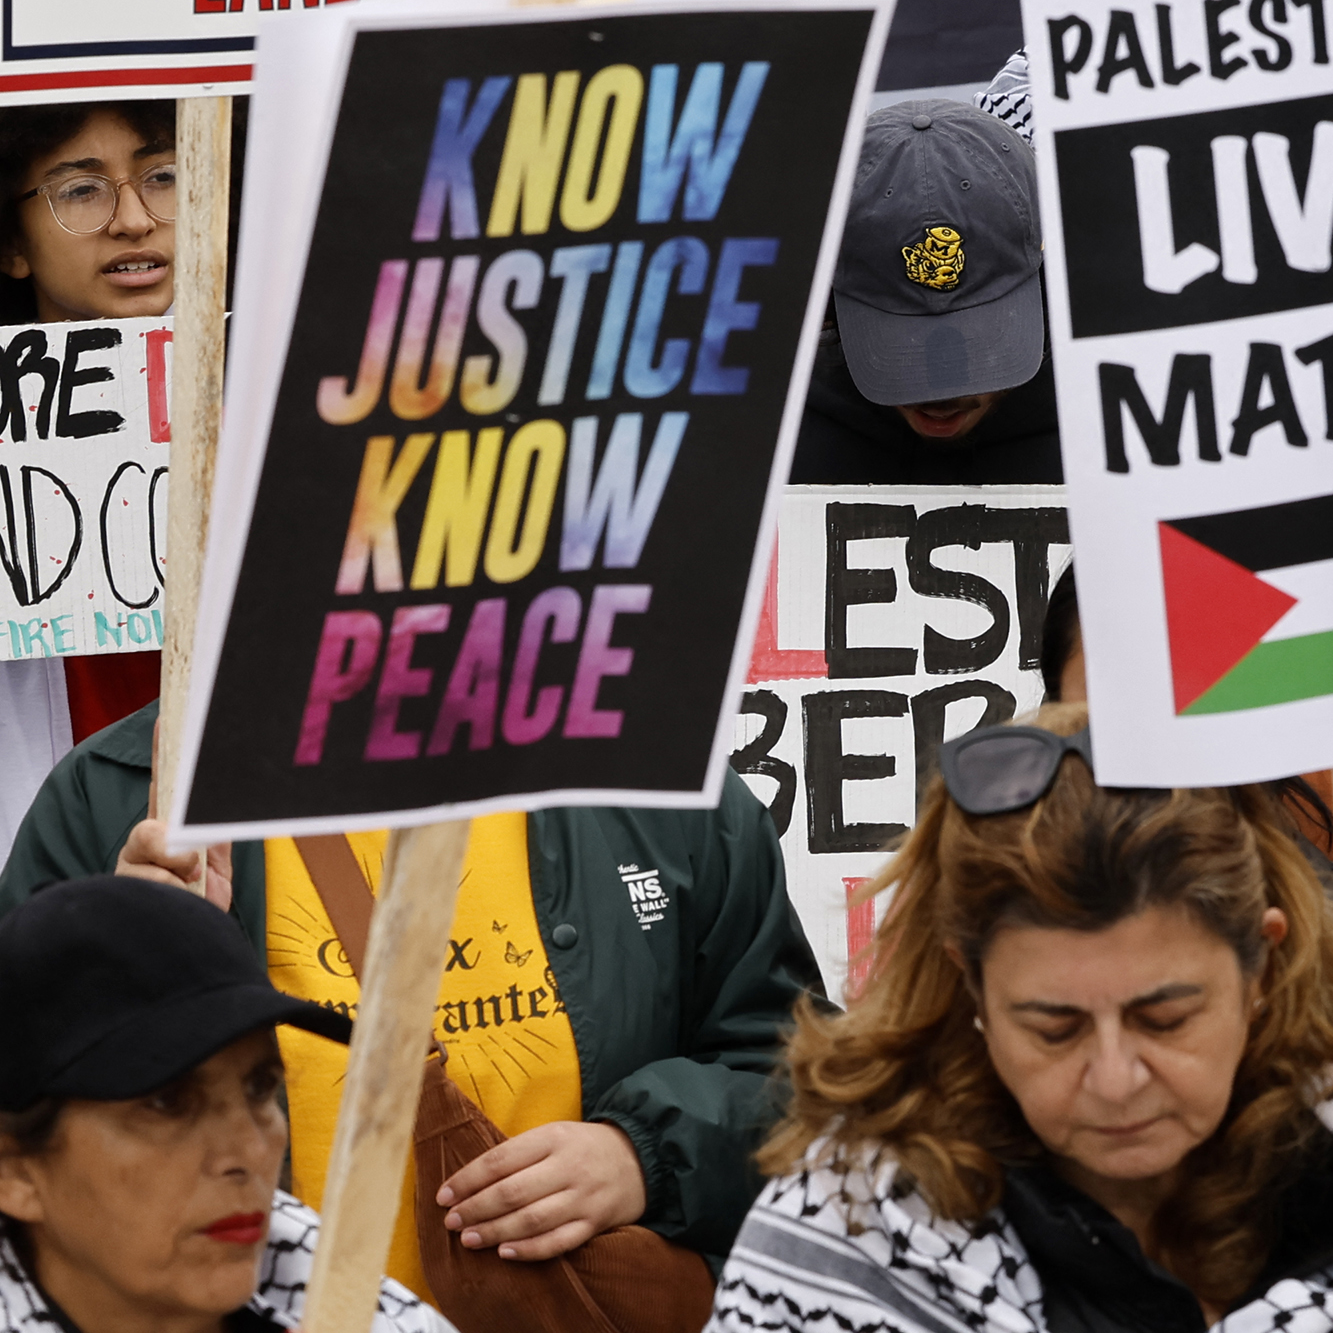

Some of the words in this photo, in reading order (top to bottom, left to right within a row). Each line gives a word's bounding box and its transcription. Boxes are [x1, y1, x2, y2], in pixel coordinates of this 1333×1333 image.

[412, 61, 771, 242] KNOW
[315, 236, 782, 425] JUSTICE
[334, 409, 690, 595] KNOW
[293, 584, 653, 768] PEACE
